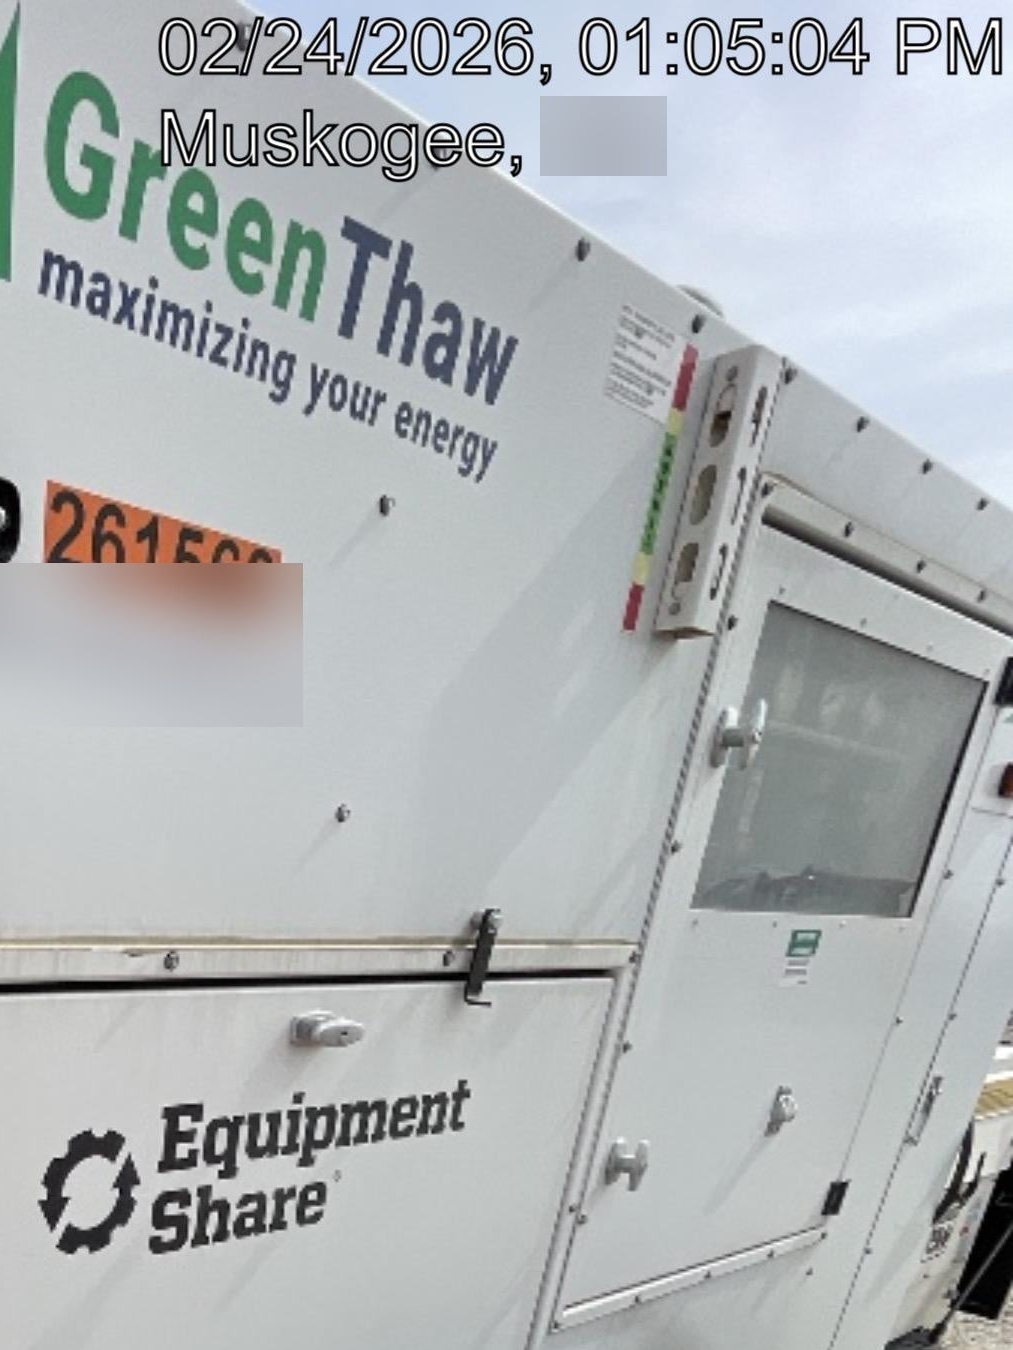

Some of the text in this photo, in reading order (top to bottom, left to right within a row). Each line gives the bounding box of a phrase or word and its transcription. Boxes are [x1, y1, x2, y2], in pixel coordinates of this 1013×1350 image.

[45, 70, 520, 407] GreenThaw
[38, 248, 498, 483] maximizing your energy
[48, 490, 275, 563] 2615
[157, 1079, 471, 1179] Equipment
[148, 1179, 328, 1255] Share
